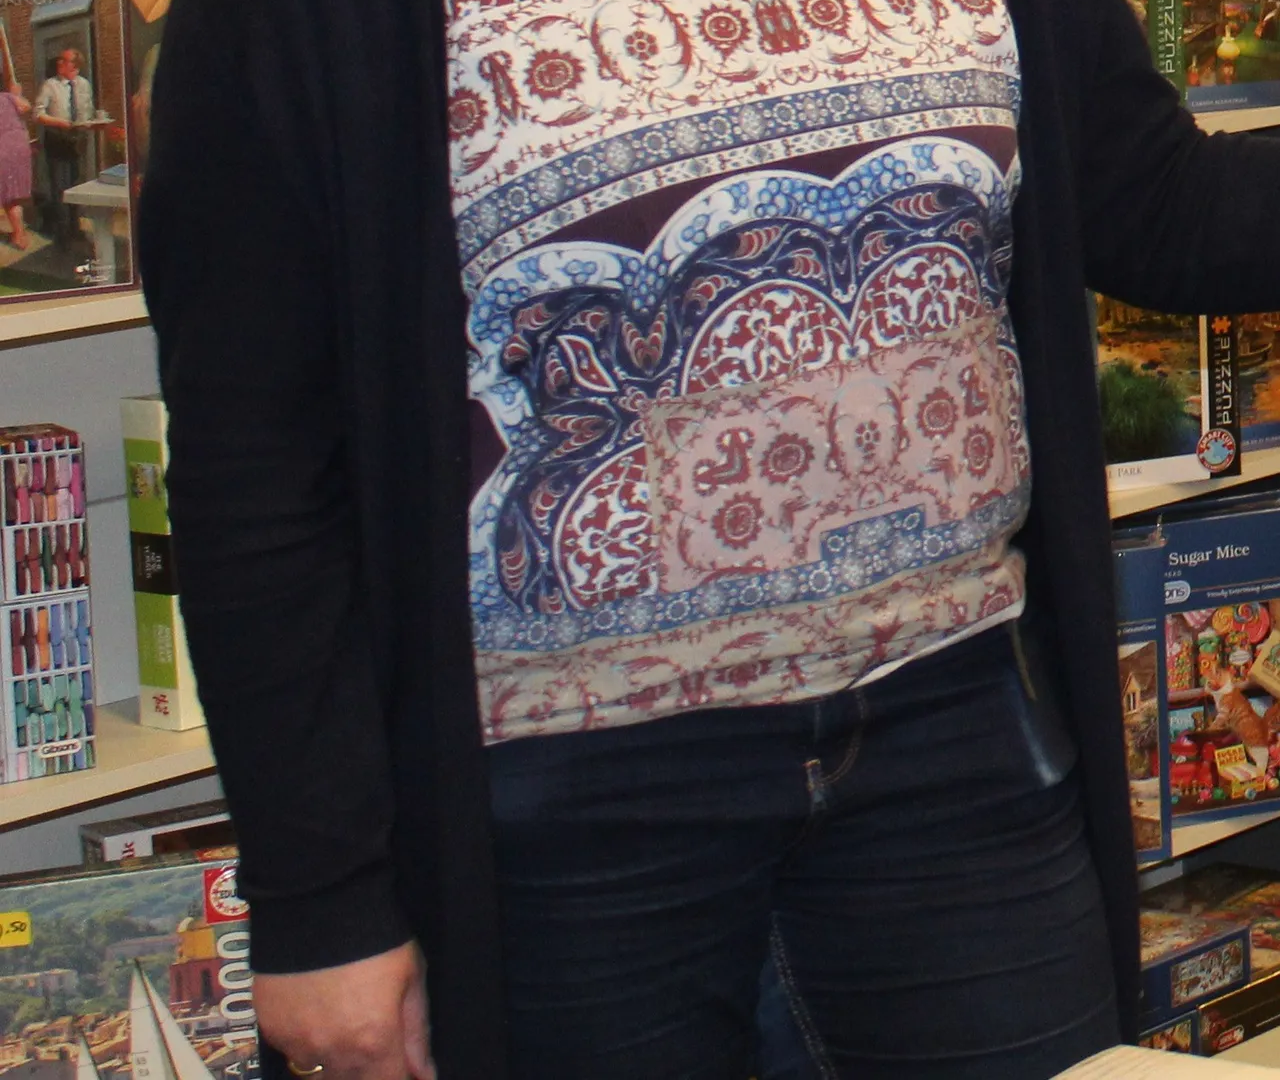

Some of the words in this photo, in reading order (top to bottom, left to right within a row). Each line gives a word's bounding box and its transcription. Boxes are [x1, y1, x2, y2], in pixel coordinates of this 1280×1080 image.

[1221, 336, 1232, 425] PUZZLE
[1118, 466, 1142, 478] PARK
[1169, 548, 1212, 567] Sugar
[1217, 544, 1250, 560] Mice
[217, 931, 258, 1045] 1000
